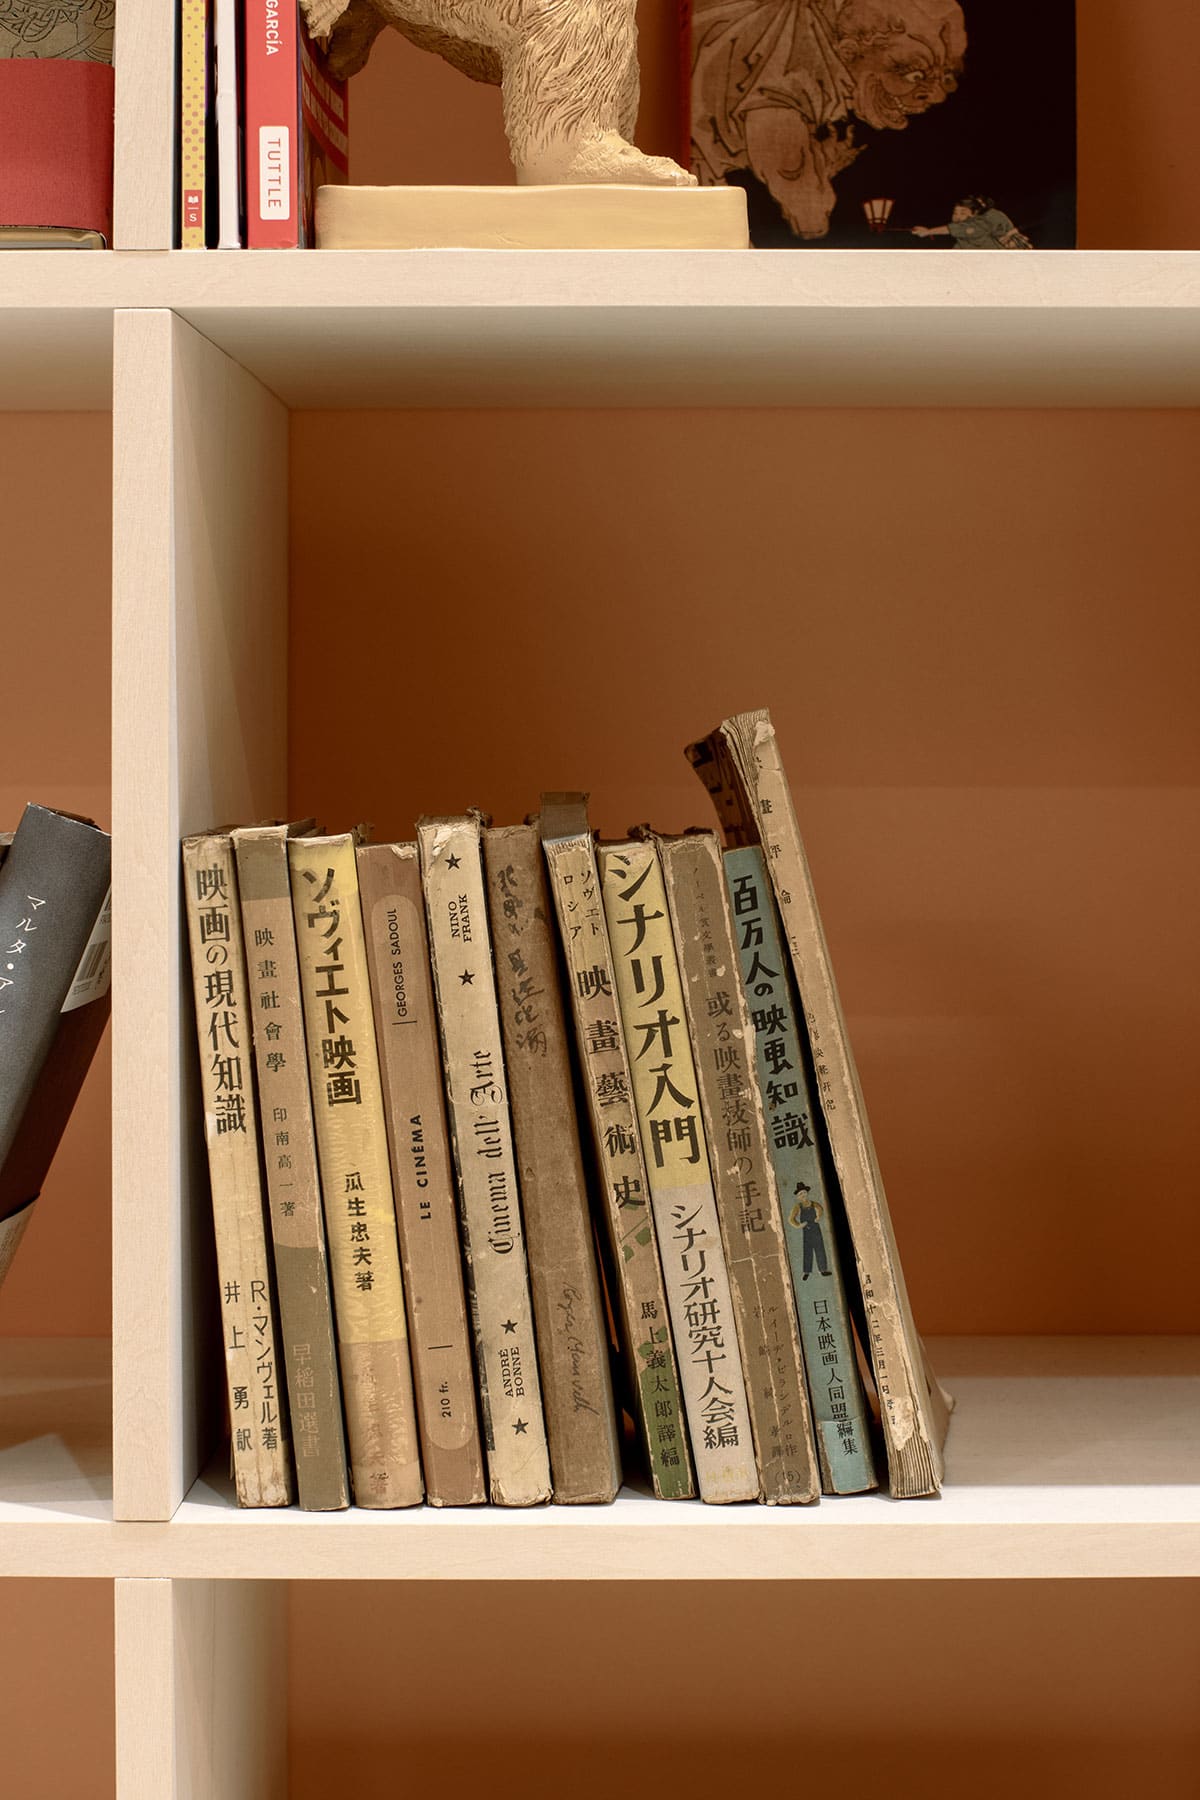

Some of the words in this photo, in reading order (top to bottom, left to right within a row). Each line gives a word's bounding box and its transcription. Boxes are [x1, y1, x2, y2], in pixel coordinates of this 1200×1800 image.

[265, 0, 282, 56] GARCÍA
[267, 137, 282, 209] TUTTLE
[189, 213, 197, 223] S
[387, 908, 401, 955] SADOUL
[449, 900, 461, 938] NINO
[458, 894, 472, 943] FRANK
[563, 874, 581, 940] ロシア
[196, 863, 247, 1135] 映画の現代知識
[254, 928, 287, 1073] 映畫社會學
[303, 867, 363, 1107] ソヴィエト映画
[396, 962, 408, 1017] GEORGES
[608, 854, 701, 1168] シナリオ入門
[577, 965, 646, 1208] 映畫藝術史
[273, 1107, 297, 1217] 印南高一著
[410, 1114, 428, 1188] CINÉMA
[345, 1172, 375, 1291] 瓜生忠夫著
[421, 1201, 431, 1220] LE
[487, 1170, 520, 1255] Cinema
[670, 1203, 740, 1450] シナリオ研究十人会編
[224, 1281, 251, 1451] 井上勇訳
[441, 1380, 449, 1394] fr.
[498, 1349, 513, 1398] ANDRÉ
[510, 1346, 524, 1397] BONNE
[813, 1300, 858, 1456] 日本映画人同盟編集
[443, 1398, 451, 1418] 210
